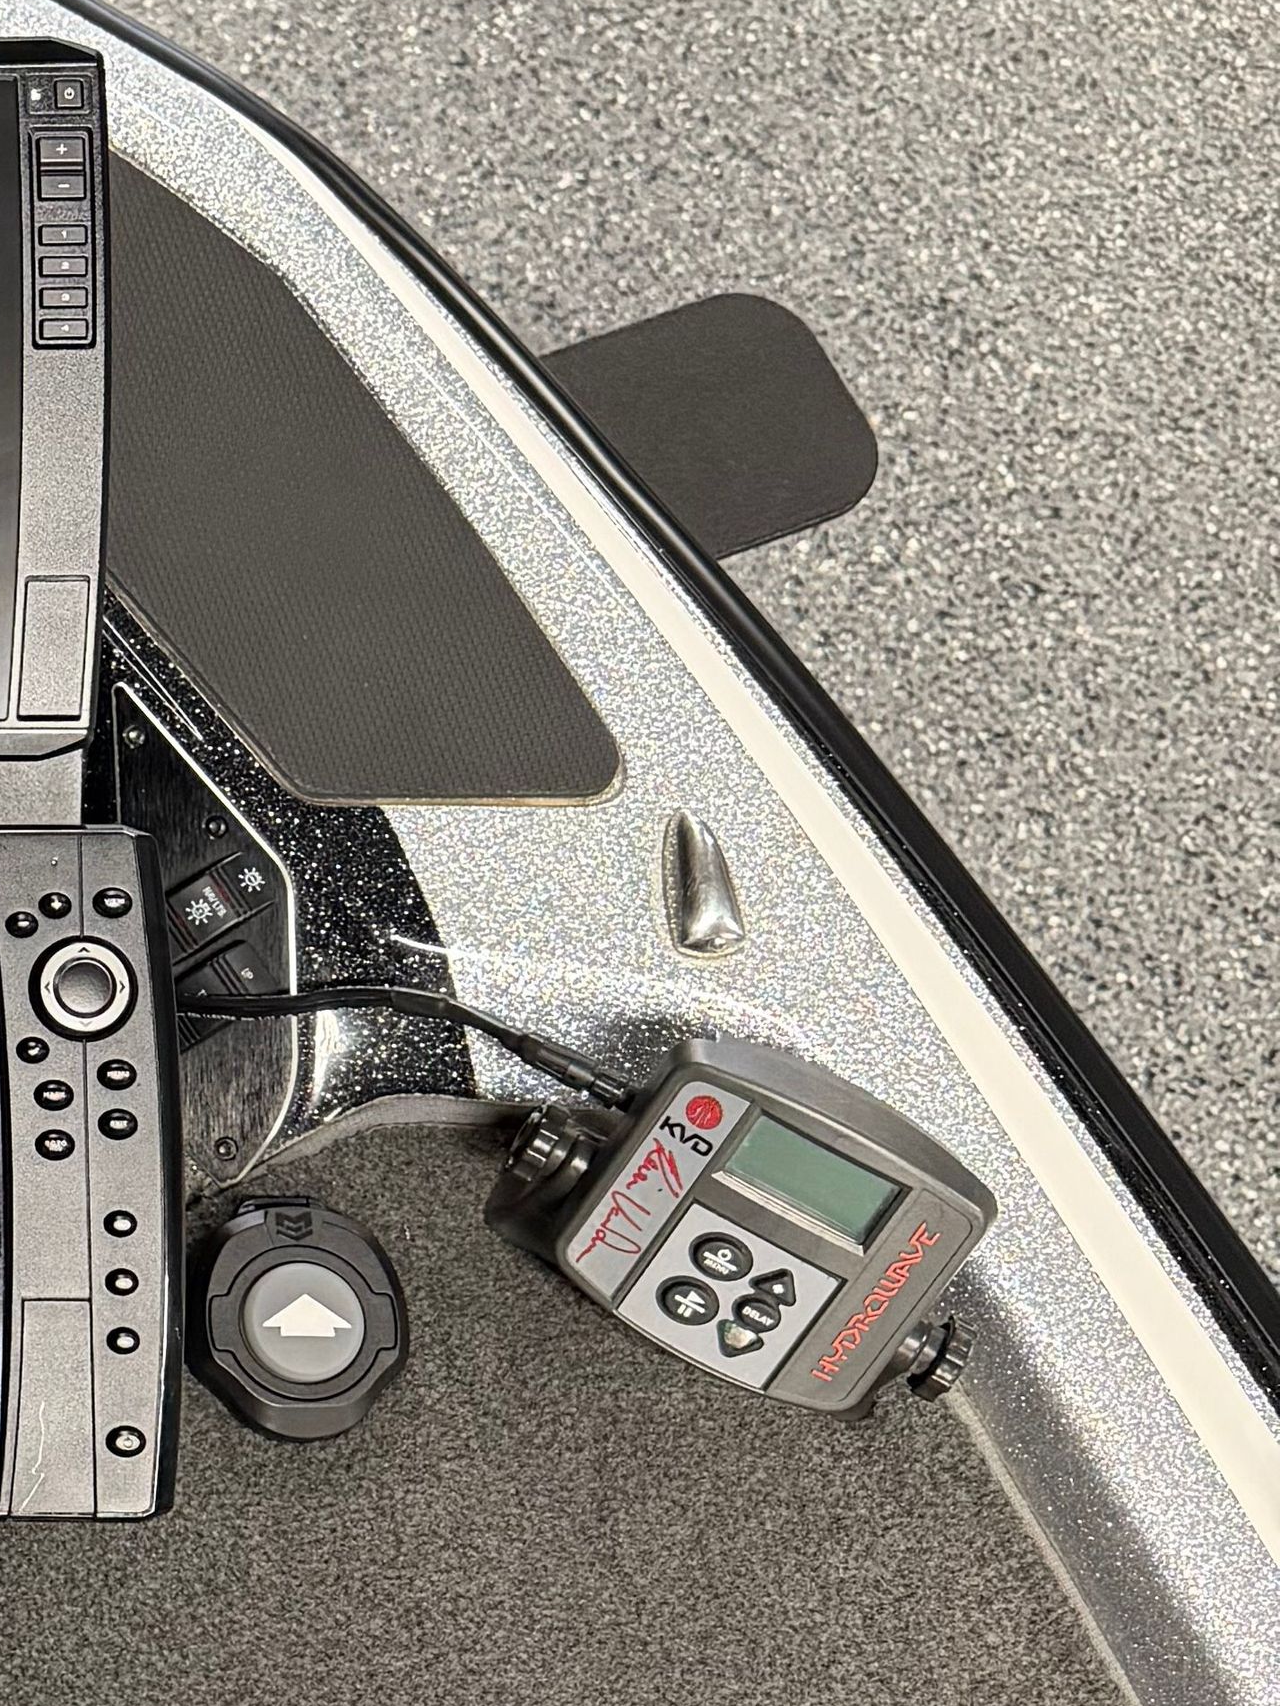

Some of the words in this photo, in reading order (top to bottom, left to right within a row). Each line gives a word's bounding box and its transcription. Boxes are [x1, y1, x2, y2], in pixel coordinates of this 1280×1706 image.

[659, 1116, 713, 1157] KVD
[742, 1305, 775, 1326] DELAY
[811, 1221, 941, 1382] HYDROWAVE
